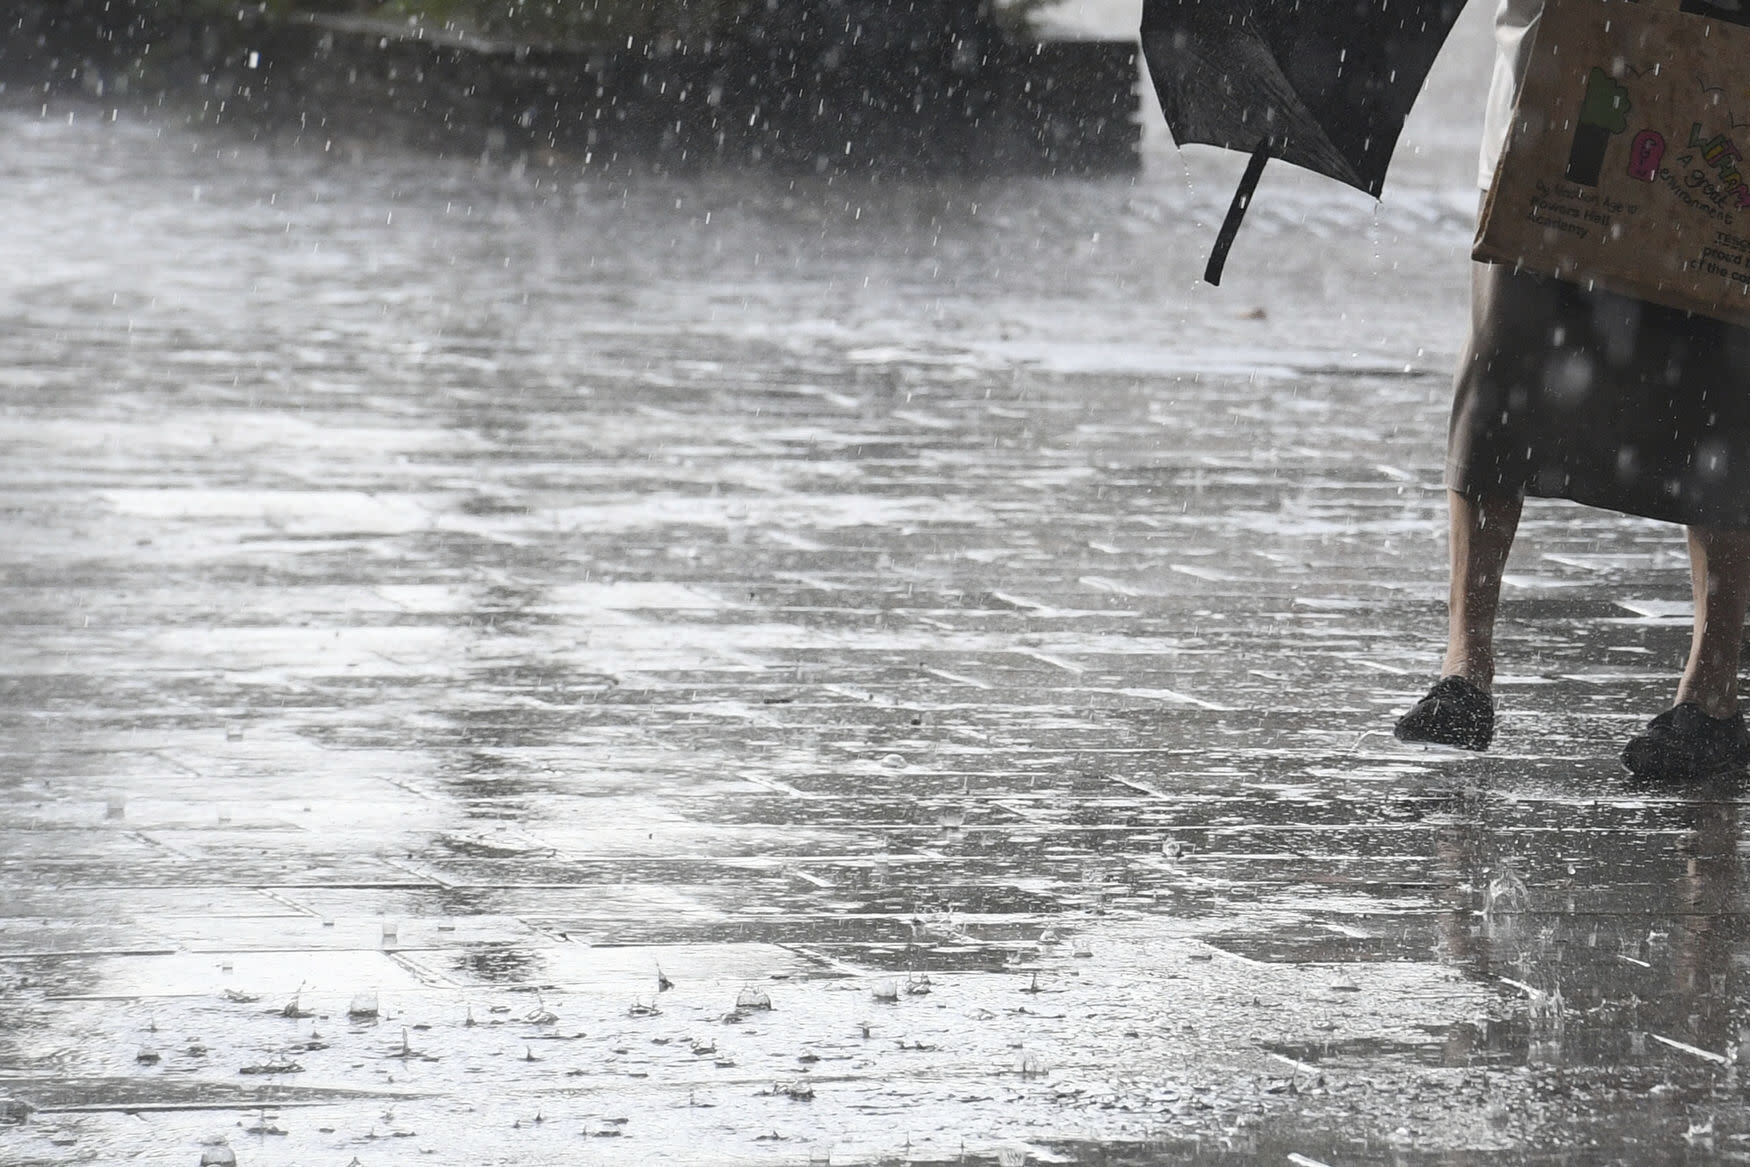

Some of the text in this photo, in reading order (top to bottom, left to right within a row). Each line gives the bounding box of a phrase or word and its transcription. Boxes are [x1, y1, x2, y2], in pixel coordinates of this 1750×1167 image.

[1660, 167, 1733, 225] environment
[1684, 169, 1728, 208] great
[1584, 210, 1611, 227] Hall
[1702, 246, 1742, 265] proud
[1690, 259, 1706, 270] of
[1707, 262, 1728, 277] the
